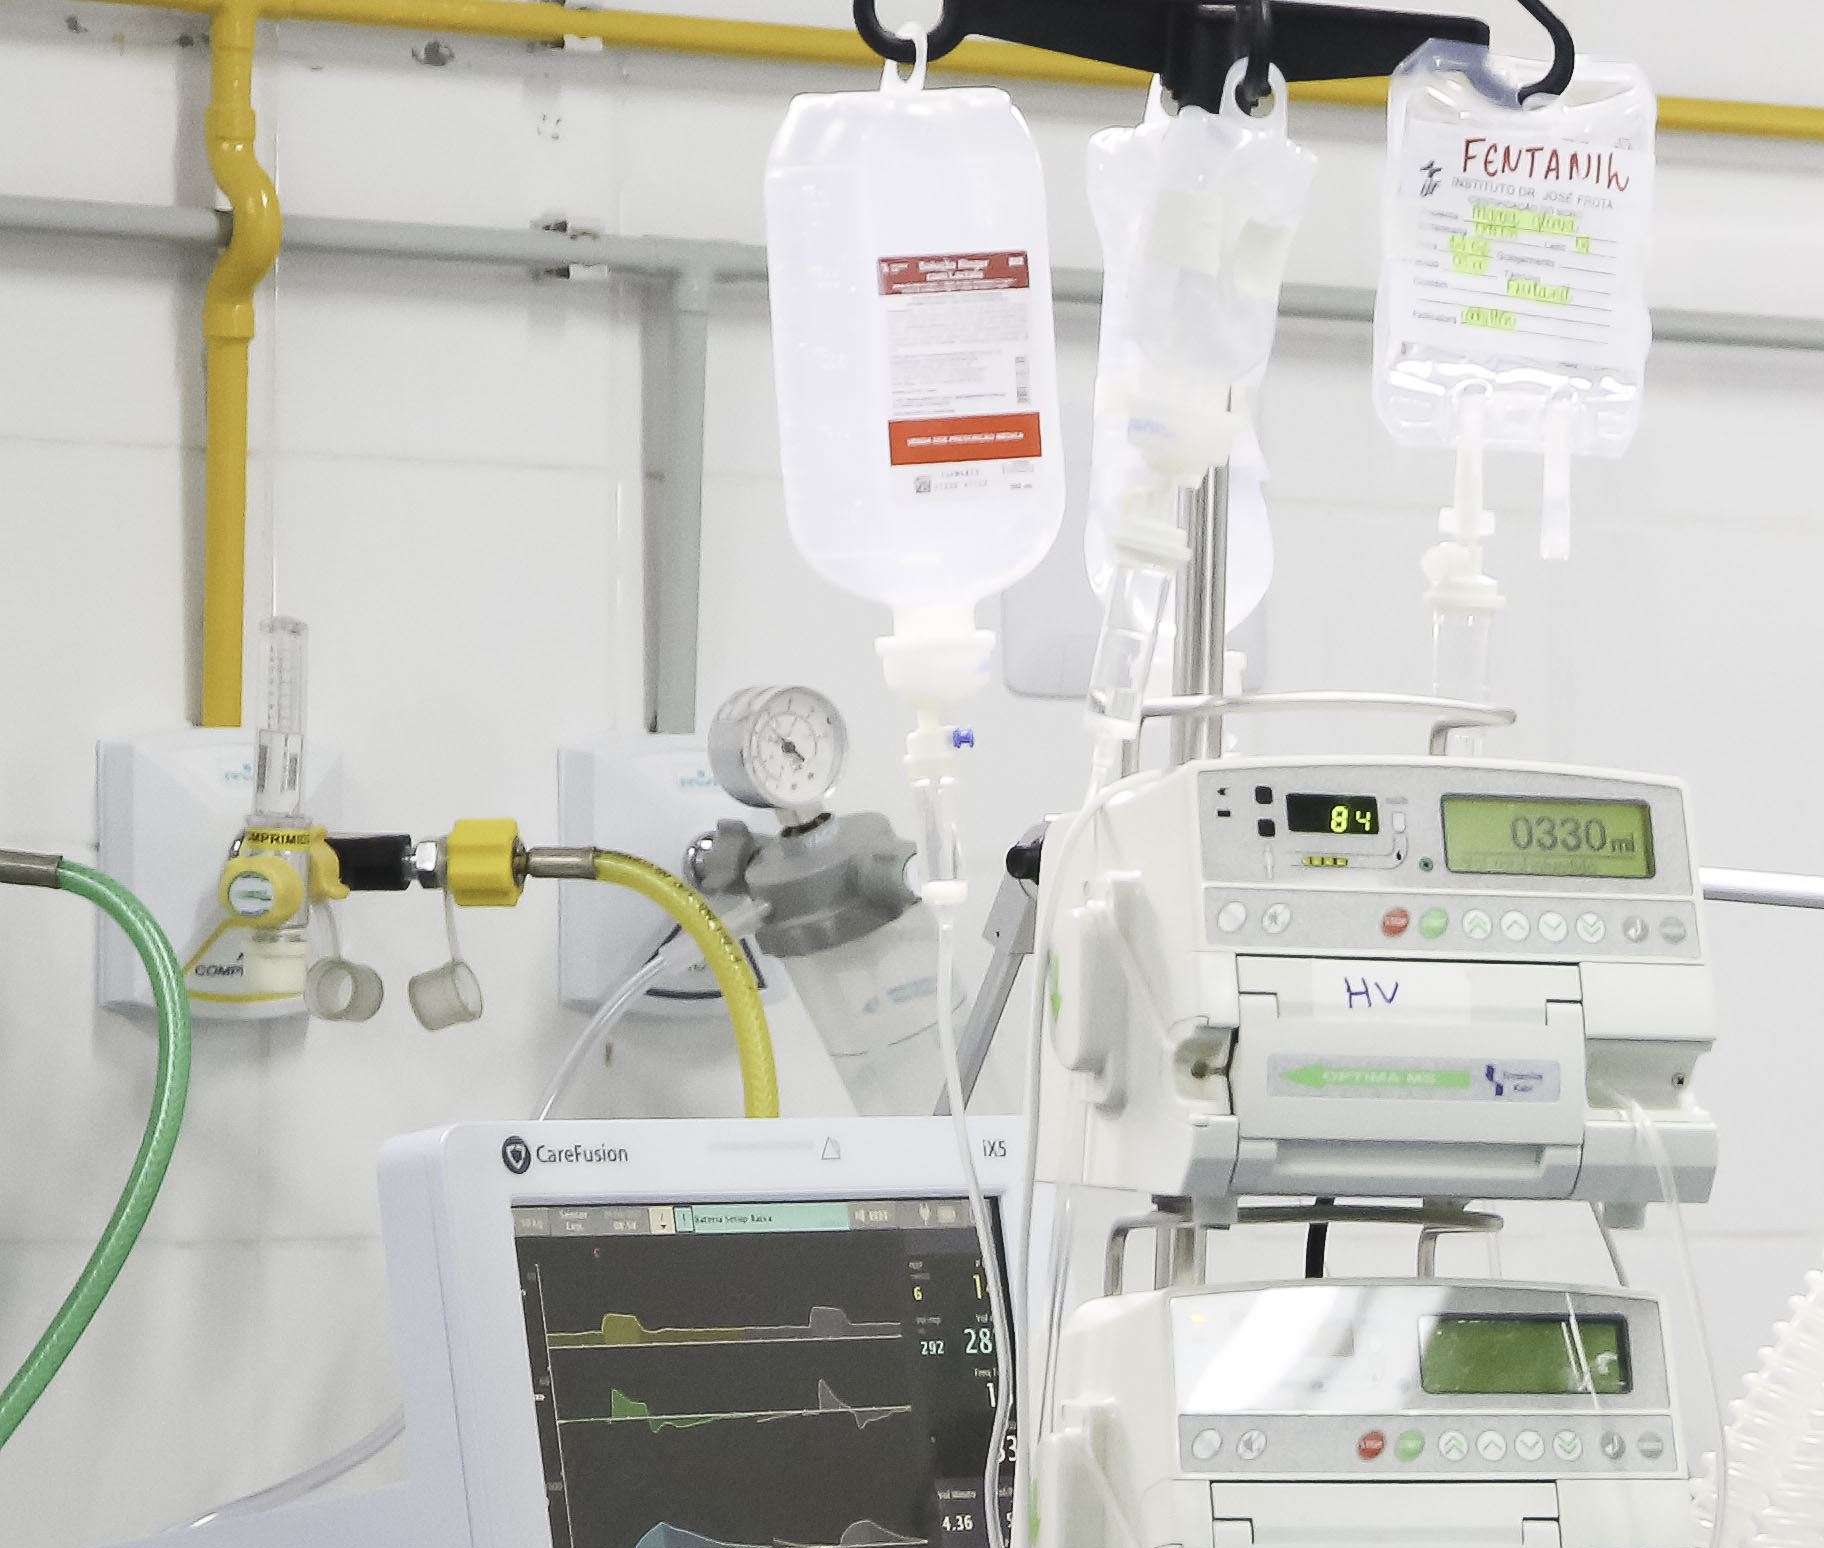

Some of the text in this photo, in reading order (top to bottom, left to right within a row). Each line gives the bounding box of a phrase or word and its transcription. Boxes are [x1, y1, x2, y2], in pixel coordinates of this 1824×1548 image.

[1510, 815, 1607, 852] 0330
[1322, 1070, 1400, 1084] OPTIMA
[536, 1143, 629, 1164] CareFusion
[920, 1340, 945, 1356] 292
[963, 1327, 994, 1355] 28
[942, 1514, 973, 1532] 4.36
